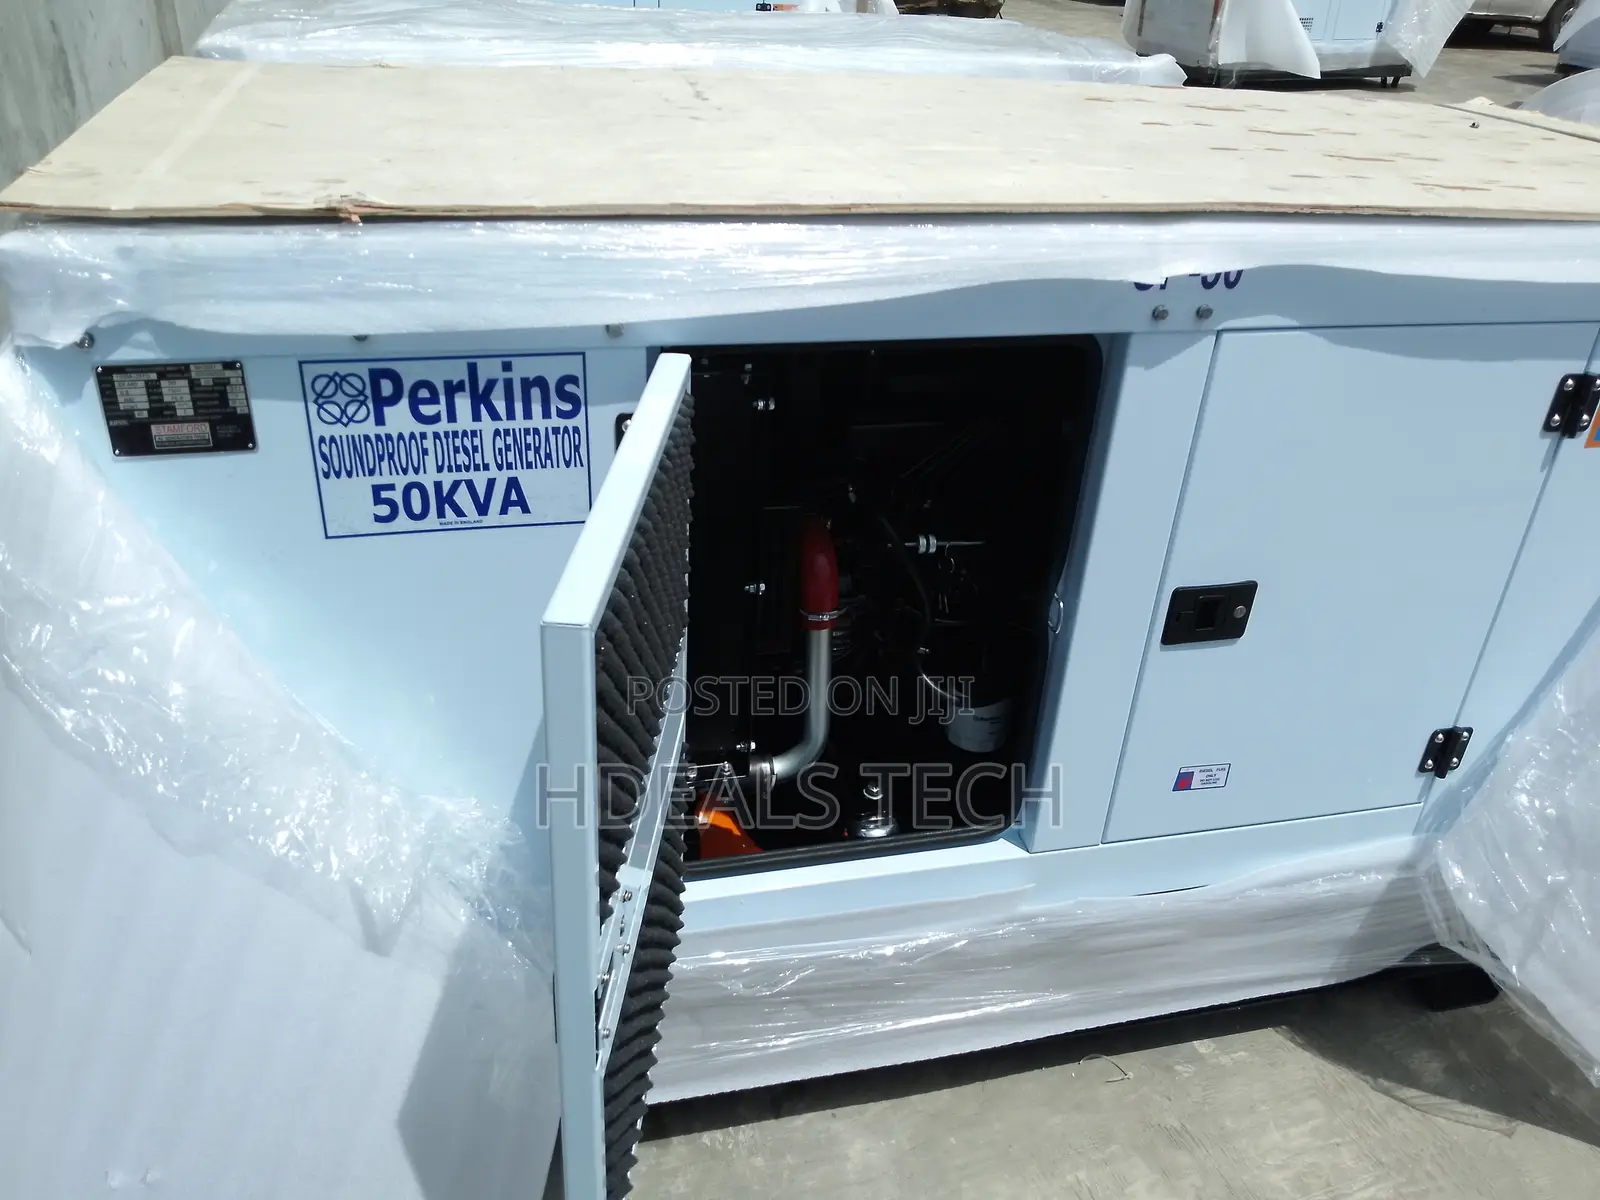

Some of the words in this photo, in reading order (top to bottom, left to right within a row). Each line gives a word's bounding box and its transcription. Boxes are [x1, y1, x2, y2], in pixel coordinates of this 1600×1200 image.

[368, 361, 582, 426] Perkins
[318, 431, 428, 480] SOUNDPROOF
[432, 429, 490, 474] DIESEL
[493, 425, 584, 471] GENERATOR
[371, 476, 532, 524] 50KVA
